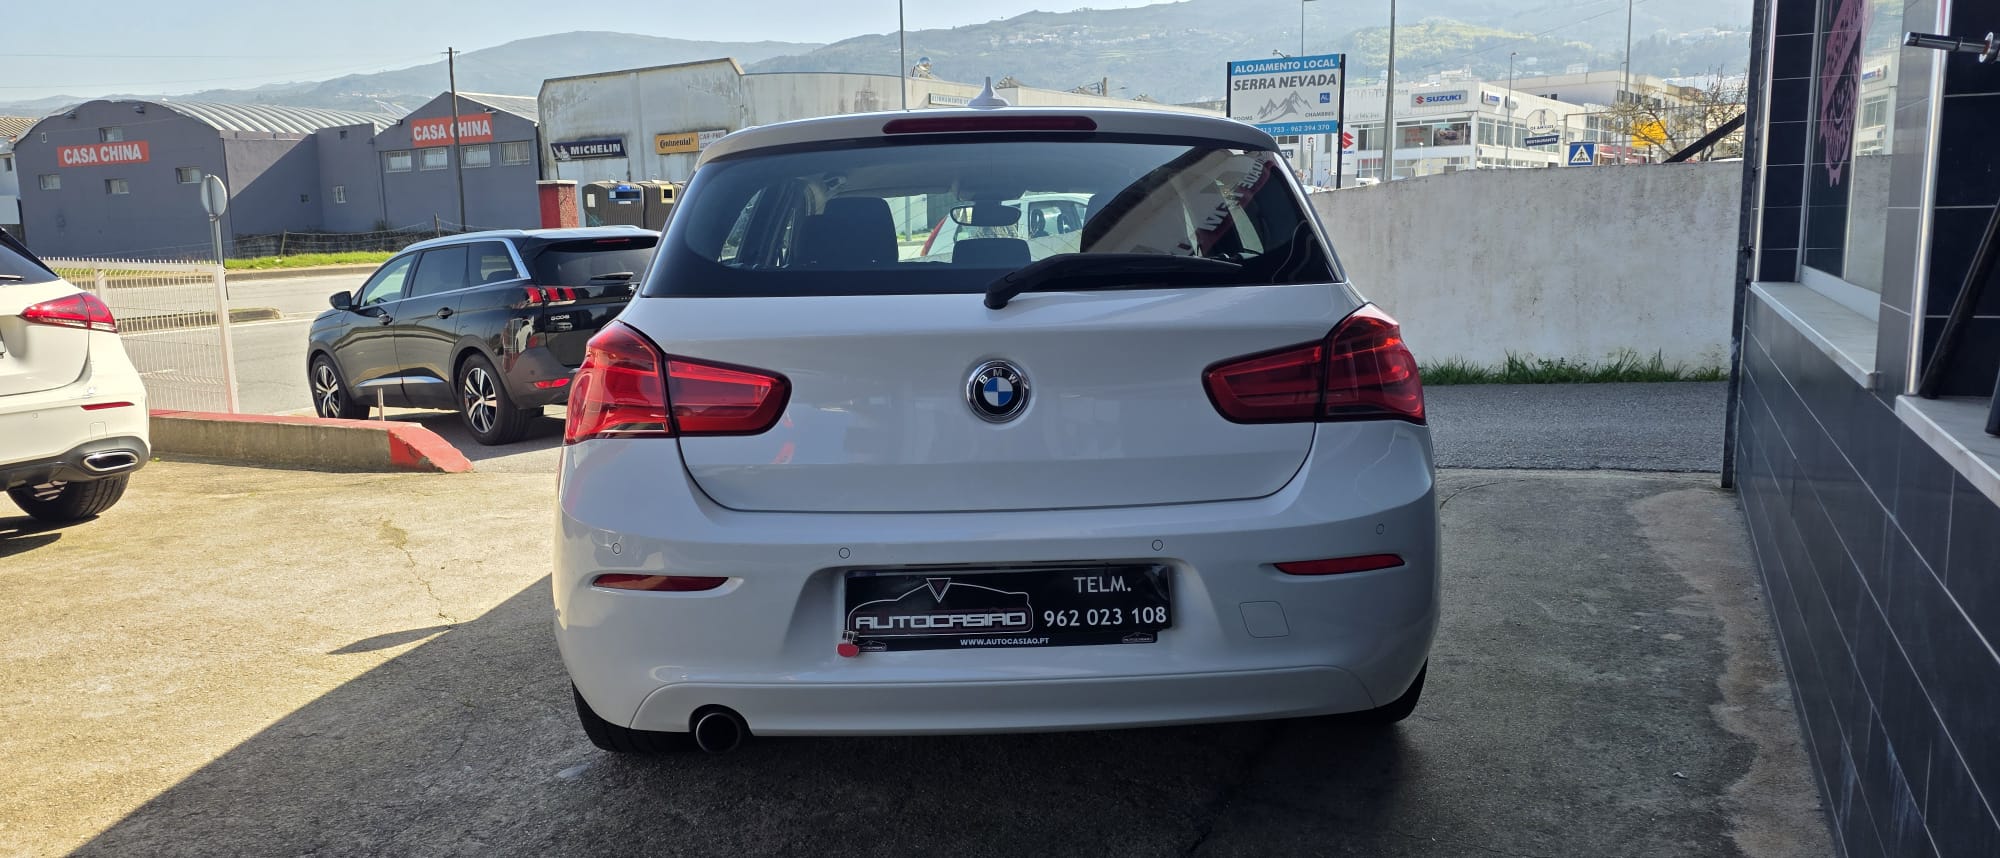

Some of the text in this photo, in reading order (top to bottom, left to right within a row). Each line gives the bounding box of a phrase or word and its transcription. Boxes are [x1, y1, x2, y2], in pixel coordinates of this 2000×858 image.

[1234, 58, 1336, 74] ALOJAMENTO LOCAL
[1233, 73, 1337, 91] SERRA NEVADA
[1426, 94, 1462, 103] SUZUKI
[413, 124, 447, 141] CASA
[570, 143, 621, 156] MICHELIN
[660, 137, 691, 149] Continental
[63, 143, 142, 164] CASA CHINA
[979, 369, 1018, 384] BMW
[1073, 576, 1132, 593] TELM.
[1044, 606, 1167, 627] 962 023 108
[960, 637, 1050, 646] WWW.AUTOCASIAO.PT
